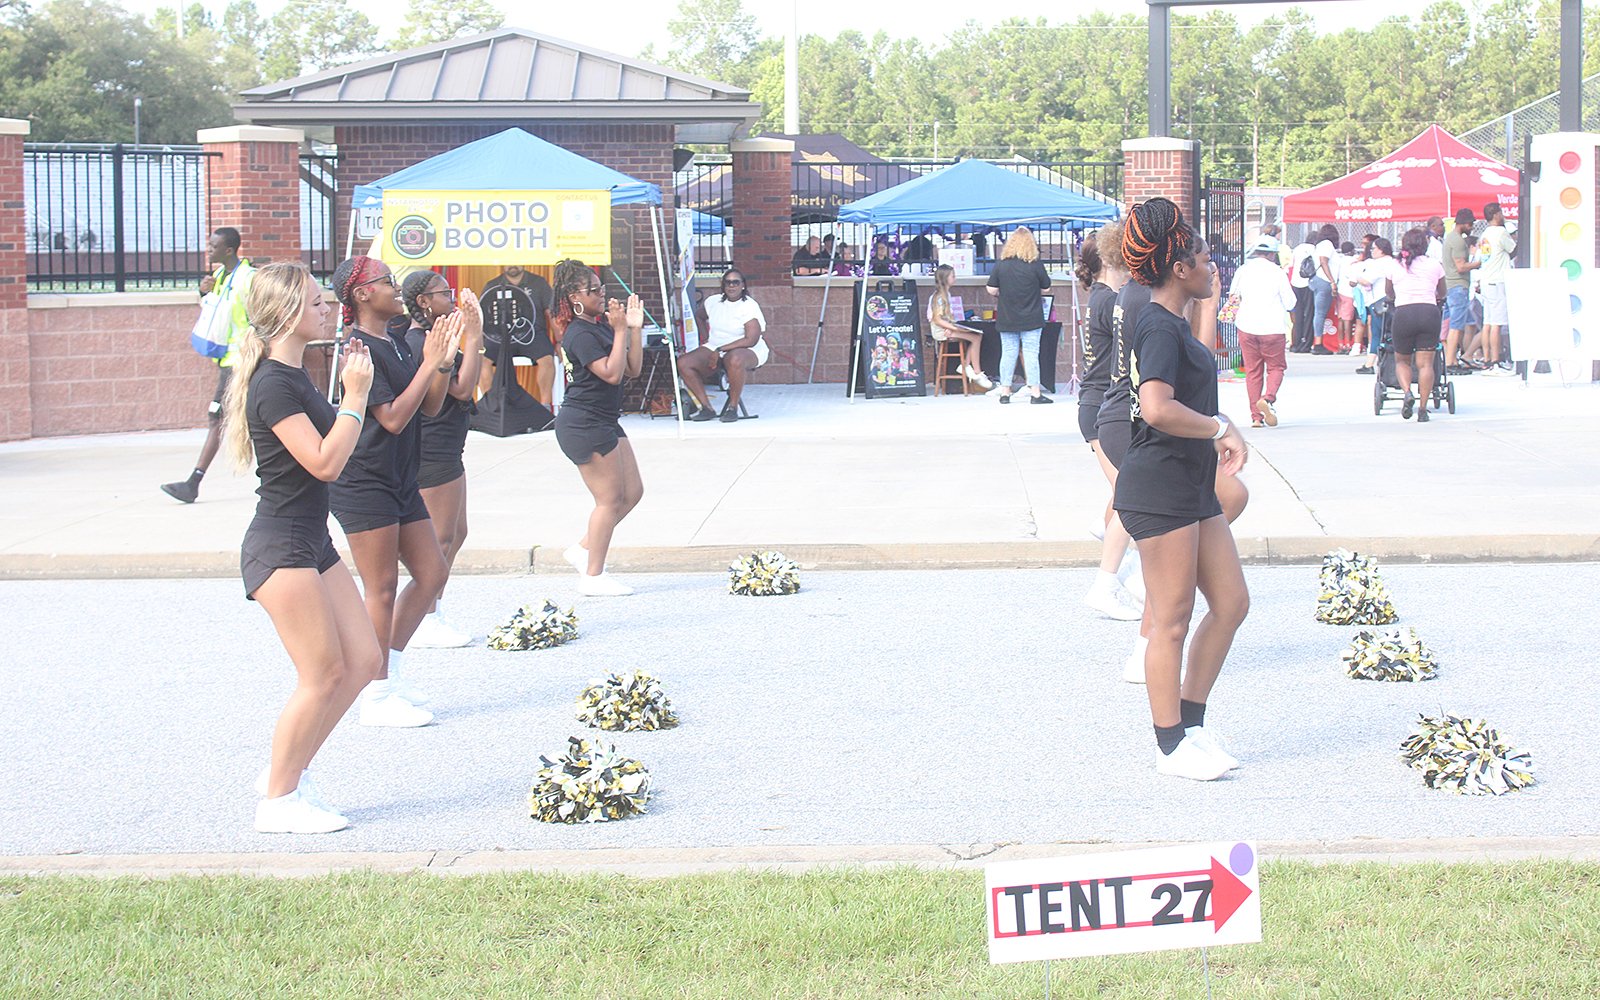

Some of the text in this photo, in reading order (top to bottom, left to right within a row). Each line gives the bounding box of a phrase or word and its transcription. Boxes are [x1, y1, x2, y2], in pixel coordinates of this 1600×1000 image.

[790, 195, 826, 209] iberty
[1366, 196, 1393, 207] Jones
[1496, 193, 1518, 204] Verde
[447, 202, 549, 223] PHOTO
[445, 227, 547, 248] BOOTH
[868, 324, 913, 334] Let's Create!
[1004, 876, 1214, 936] TENT 27
